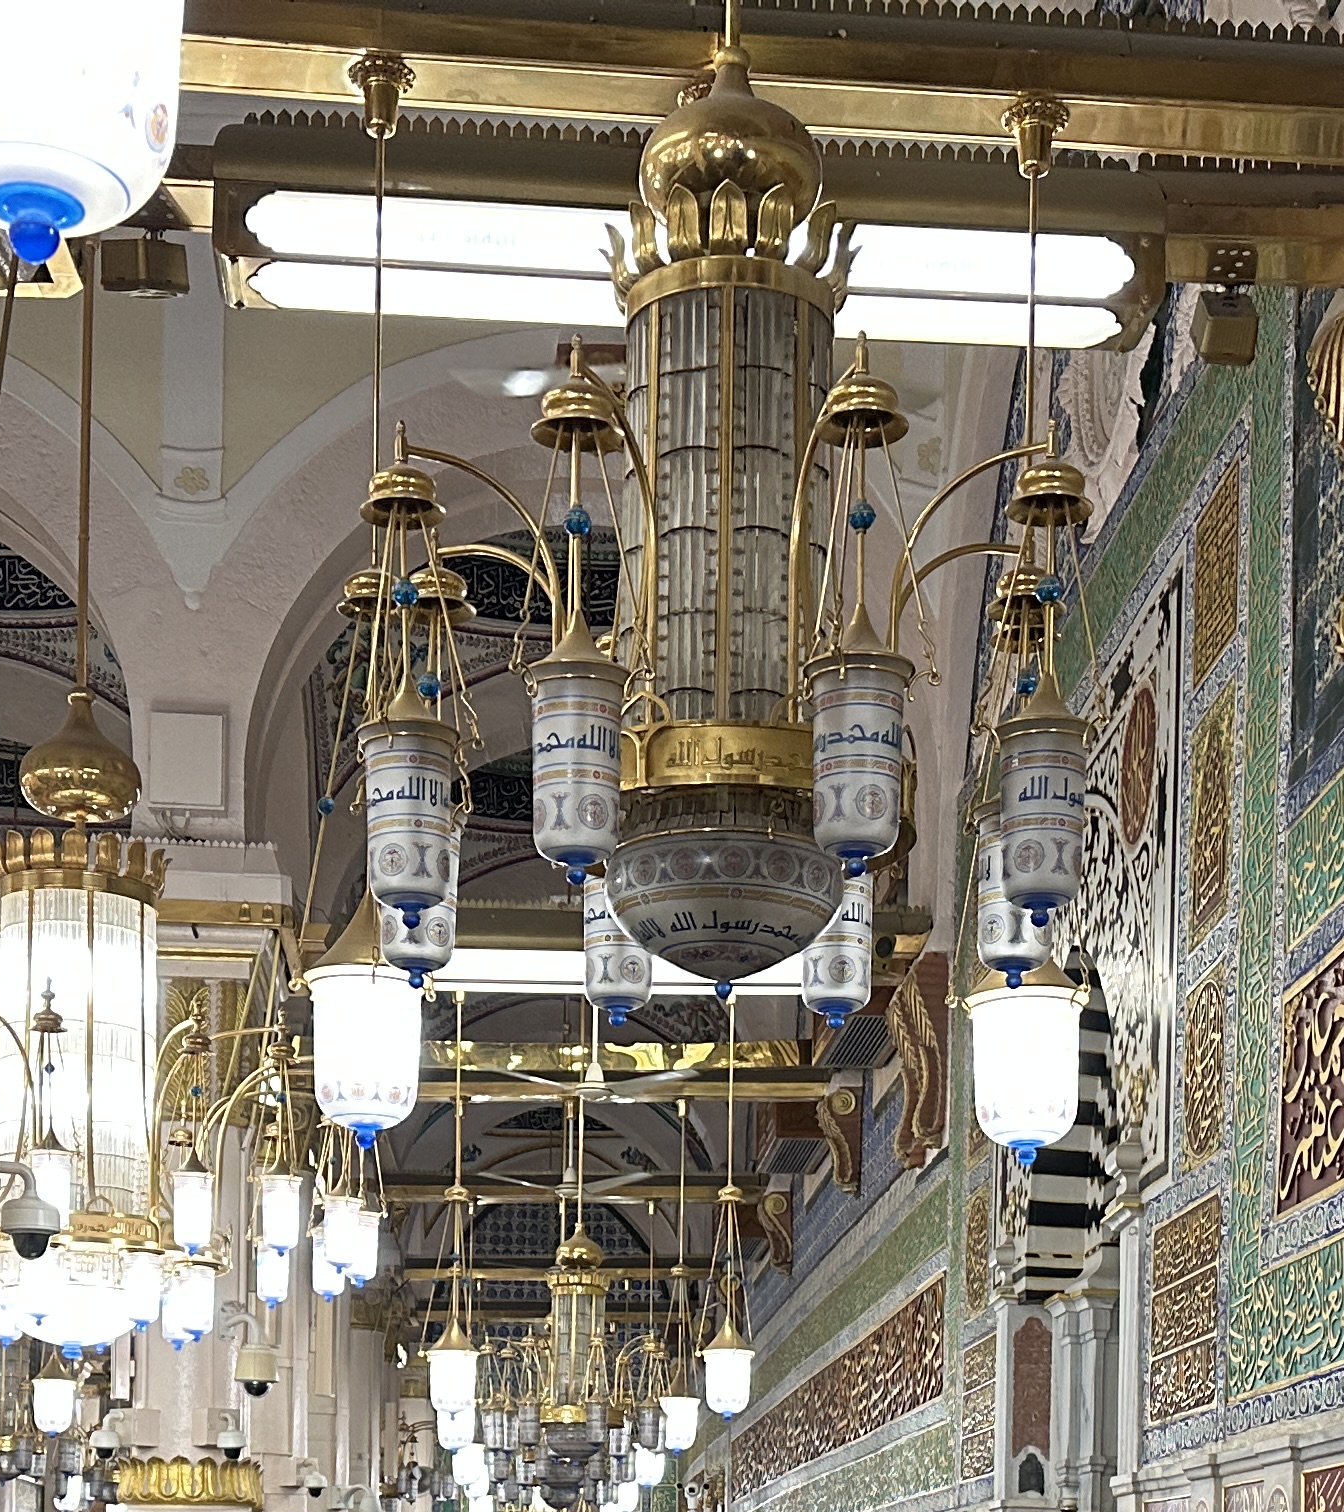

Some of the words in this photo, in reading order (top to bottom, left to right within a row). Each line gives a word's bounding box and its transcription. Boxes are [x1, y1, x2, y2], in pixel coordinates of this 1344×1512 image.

[576, 725, 606, 751] الله
[827, 724, 879, 747] محمد
[666, 739, 701, 769] الله
[396, 776, 426, 802] الله
[1018, 774, 1050, 803] الله
[670, 911, 698, 934] الله
